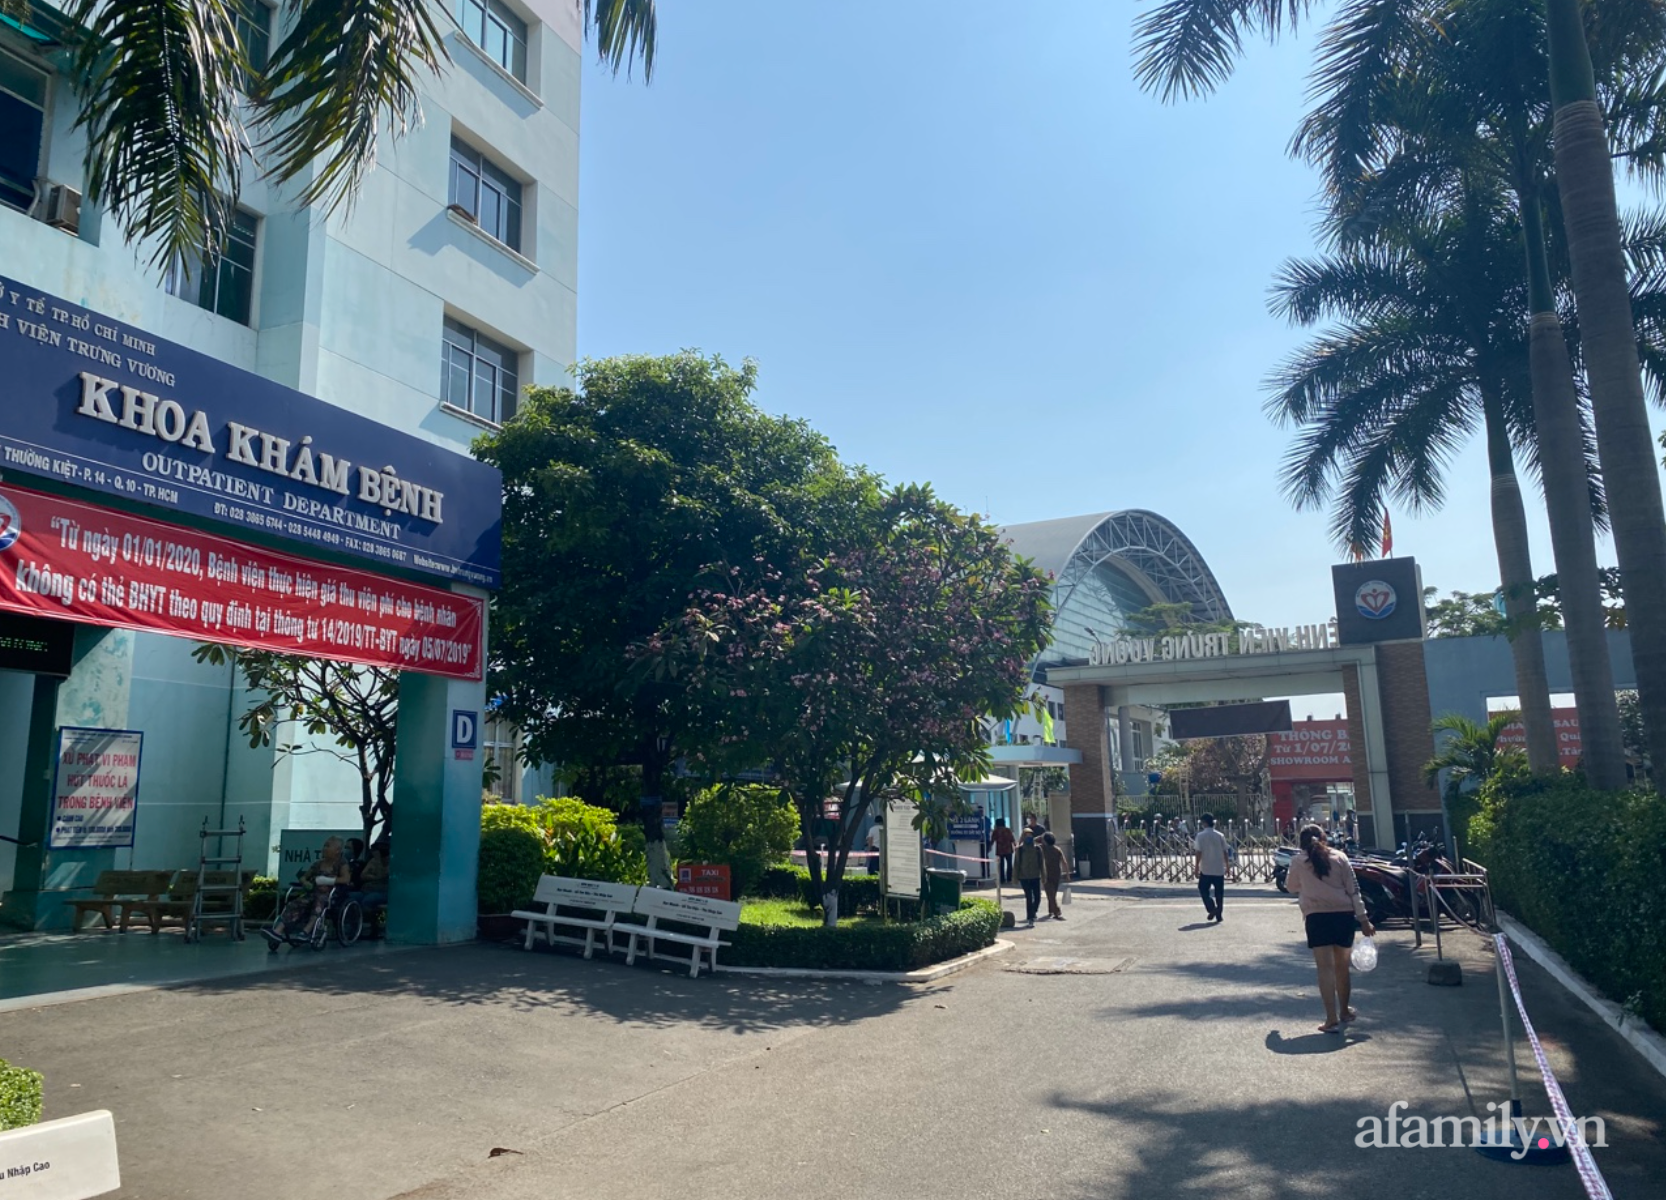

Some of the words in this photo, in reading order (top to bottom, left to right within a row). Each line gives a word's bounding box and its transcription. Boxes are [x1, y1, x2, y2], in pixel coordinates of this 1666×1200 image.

[17, 318, 61, 347] VIỆN
[67, 336, 122, 369] TRƯNG
[127, 358, 176, 387] VƯƠNG
[122, 333, 156, 356] MINH
[77, 371, 216, 454] KHOA
[226, 421, 351, 496] KHÁM
[357, 464, 444, 524] BỆNH
[126, 479, 136, 493] 10
[142, 452, 274, 505] OUTPATIENT
[283, 491, 401, 540] DEPARTMENT
[83, 527, 119, 565] ngày
[122, 532, 203, 581] 01/01/2020,
[207, 551, 238, 588] Bệnh
[241, 560, 265, 594] viện
[268, 566, 292, 599] thực
[295, 572, 318, 604] hiện
[320, 578, 337, 607] giá
[339, 582, 355, 607] thu
[357, 586, 377, 616] viện
[379, 591, 394, 618] phí
[396, 595, 412, 618] cho
[413, 598, 435, 627] bệnh
[15, 558, 74, 606] không
[77, 572, 97, 603] có
[101, 575, 125, 608] thẻ
[128, 580, 166, 614] BHYT
[169, 588, 197, 620] theo
[201, 600, 223, 630] quy
[226, 599, 251, 633] định
[255, 605, 271, 638] tại
[273, 609, 304, 643] thông
[306, 615, 319, 640] tư
[321, 617, 397, 653] 14/2019/TT-BYT
[399, 633, 421, 662] ngày
[456, 714, 474, 744] D
[1278, 728, 1332, 741] THÔNG
[102, 753, 111, 765] VI
[1270, 756, 1339, 765] SHOWROOM
[88, 770, 115, 787] THUỐC
[58, 795, 87, 809] TRONG
[89, 793, 112, 811] BỆNH
[284, 847, 311, 862] NHÀ
[33, 1161, 50, 1172] Cao
